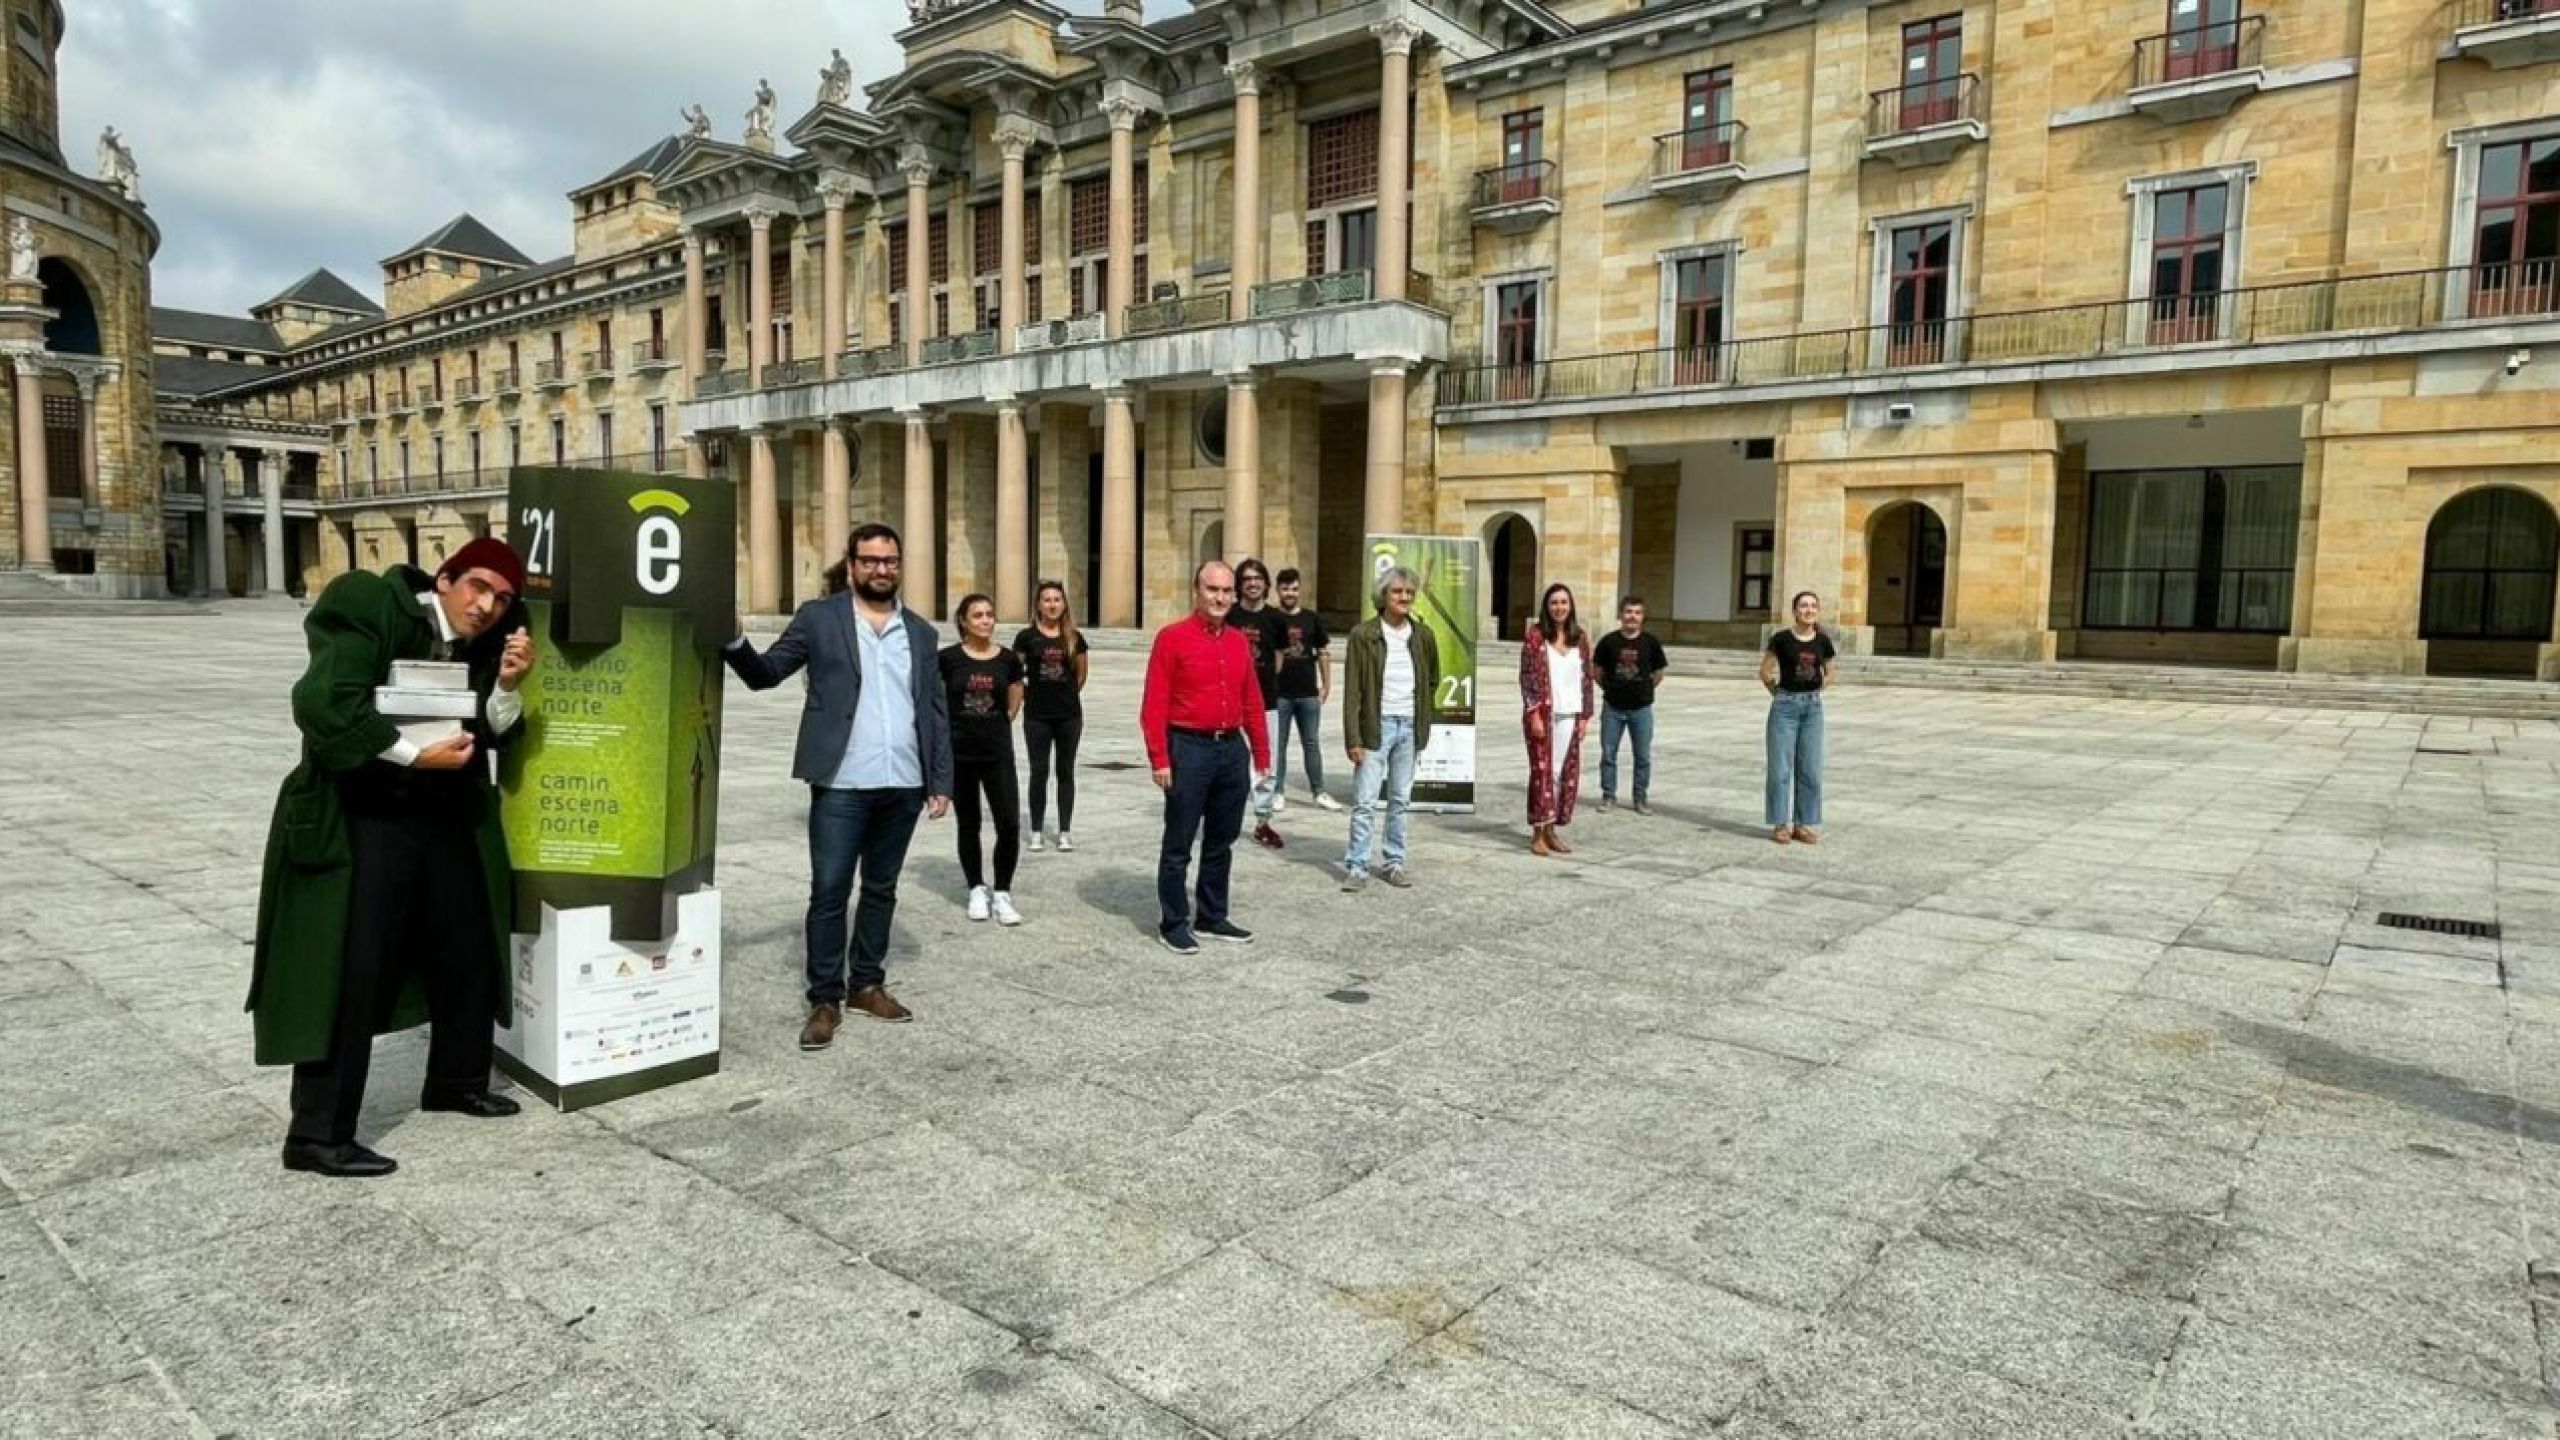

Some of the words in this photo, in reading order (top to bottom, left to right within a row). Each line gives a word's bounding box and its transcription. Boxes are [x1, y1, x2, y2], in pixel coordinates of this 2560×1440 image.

[542, 675, 624, 695] escena
[541, 697, 603, 715] norte
[540, 796, 620, 815] escena
[540, 817, 600, 835] norte
